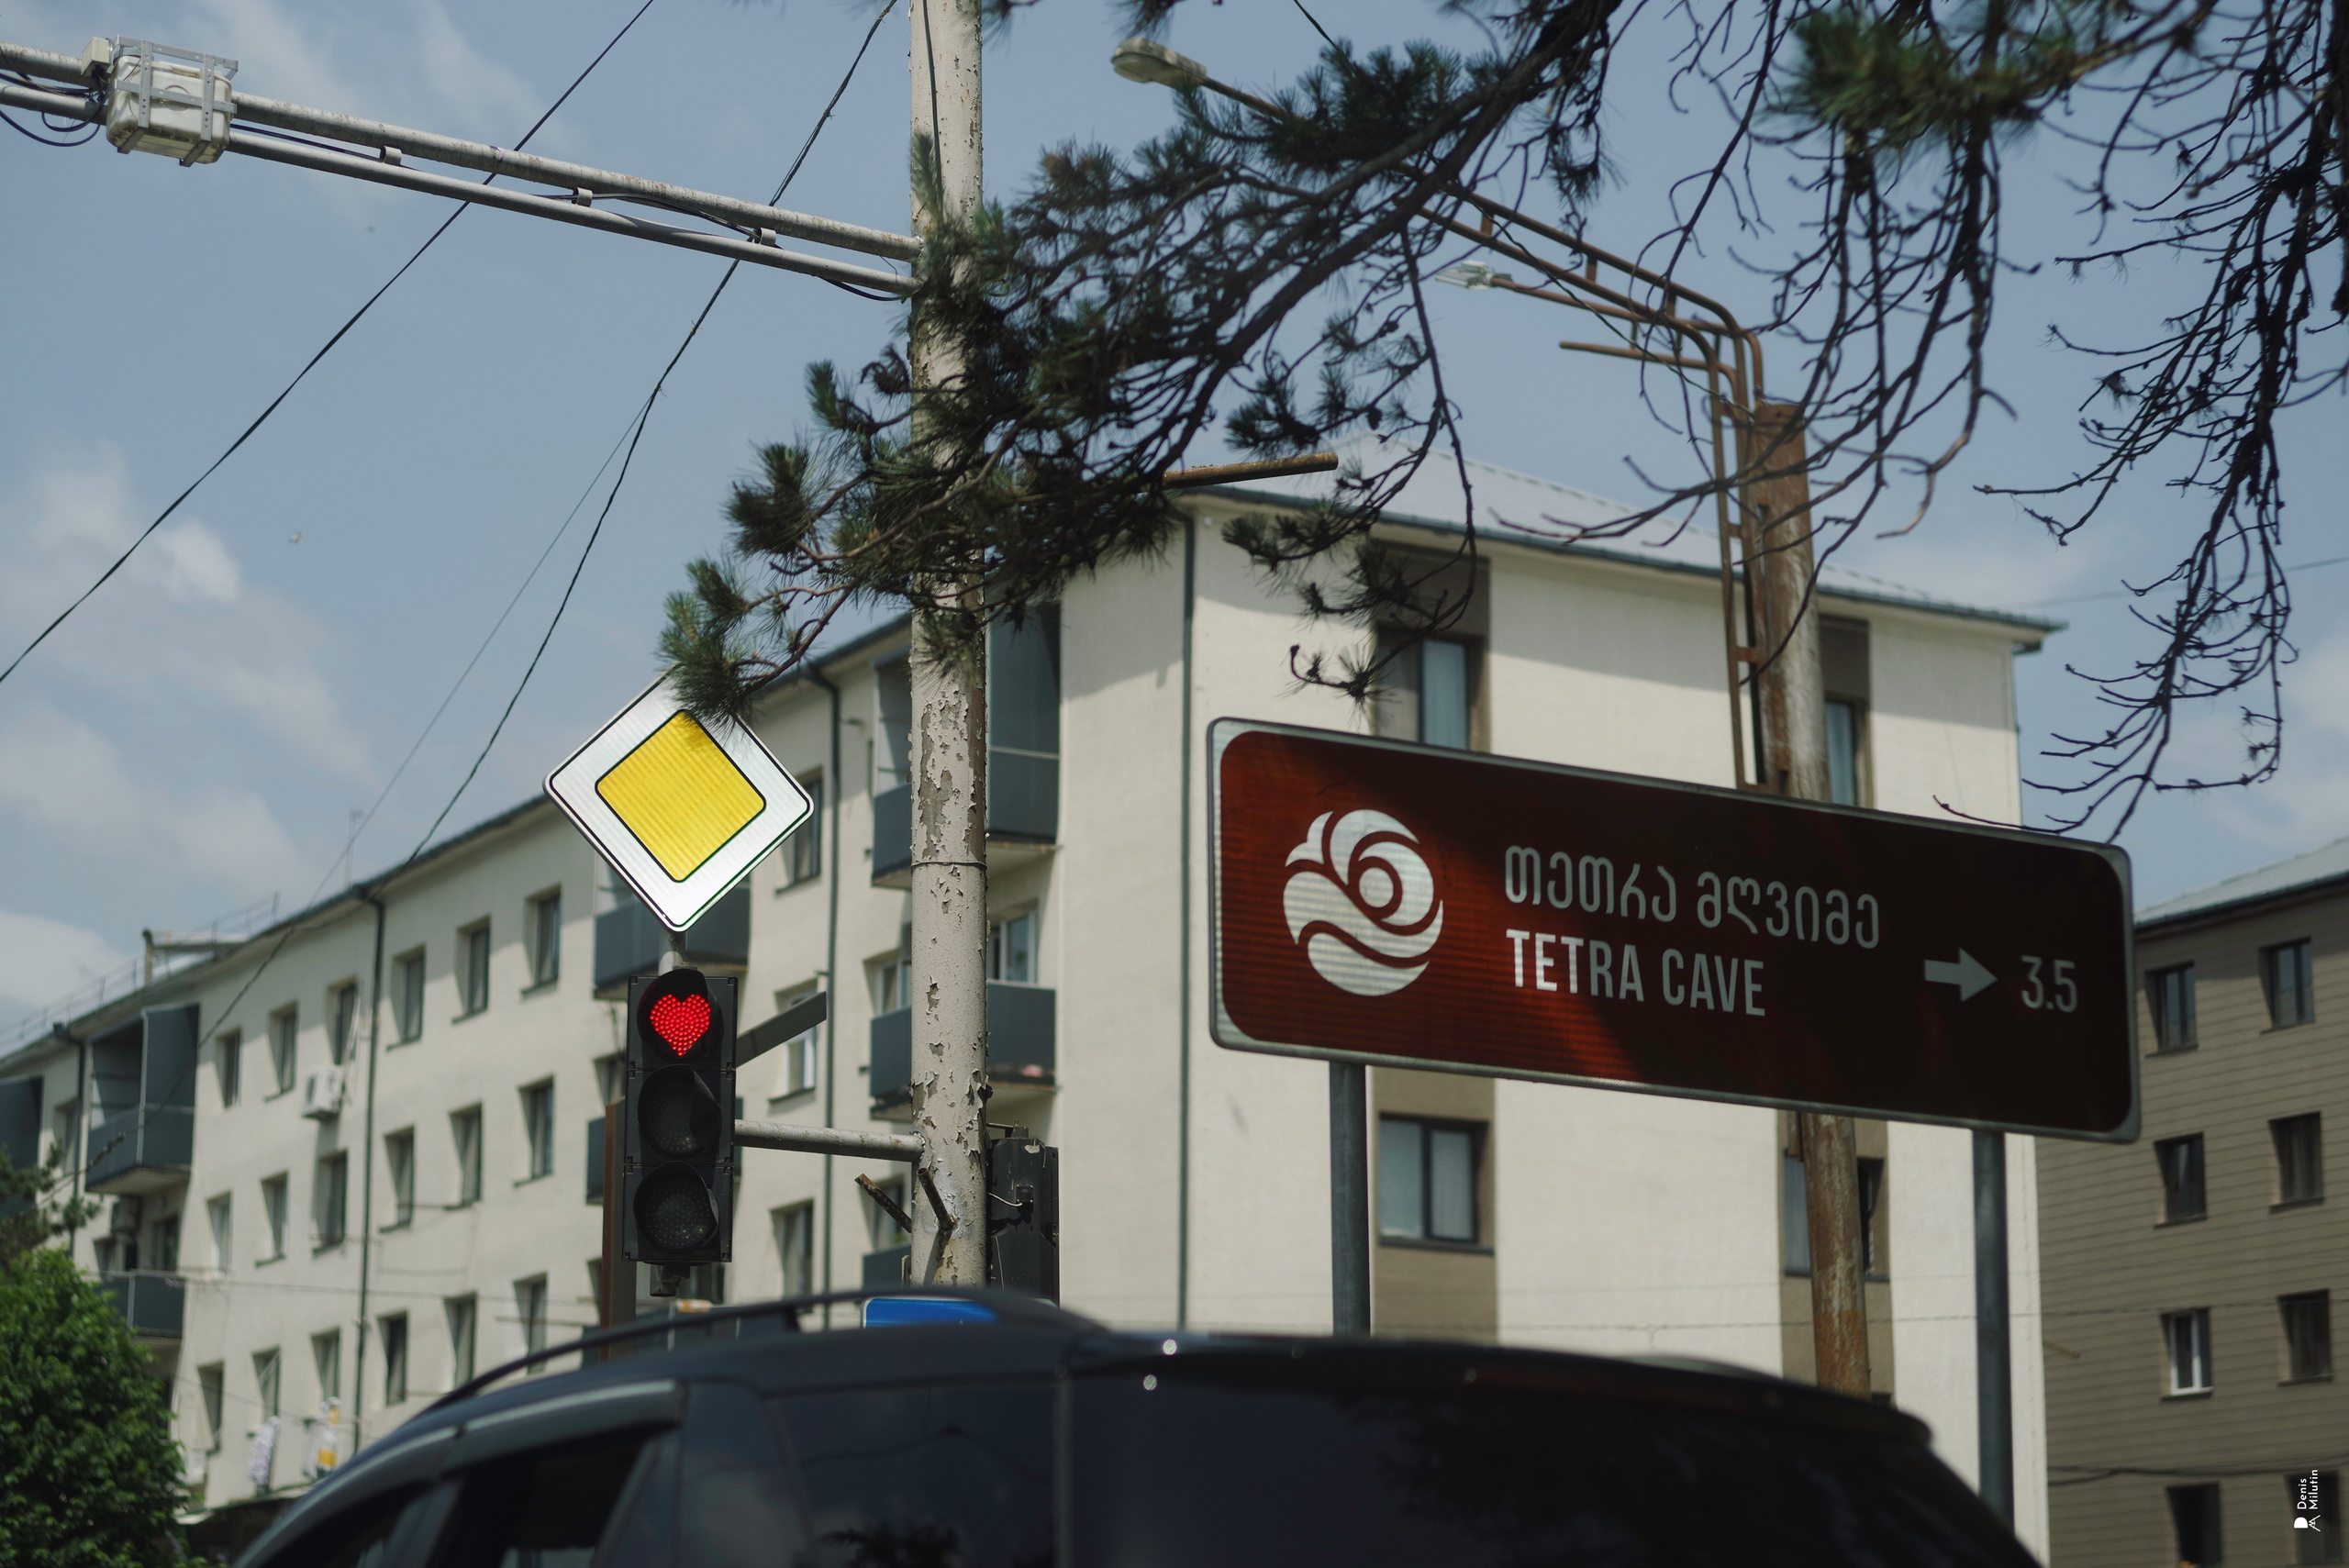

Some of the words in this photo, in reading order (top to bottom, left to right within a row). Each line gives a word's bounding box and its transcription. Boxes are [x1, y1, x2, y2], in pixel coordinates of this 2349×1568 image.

[1505, 845, 1677, 922] თეთრა
[1697, 872, 1879, 949] მღვიმე
[1506, 929, 1644, 1002] TETRA
[1662, 948, 1765, 1017] CAVE
[2021, 955, 2076, 1012] 3.5
